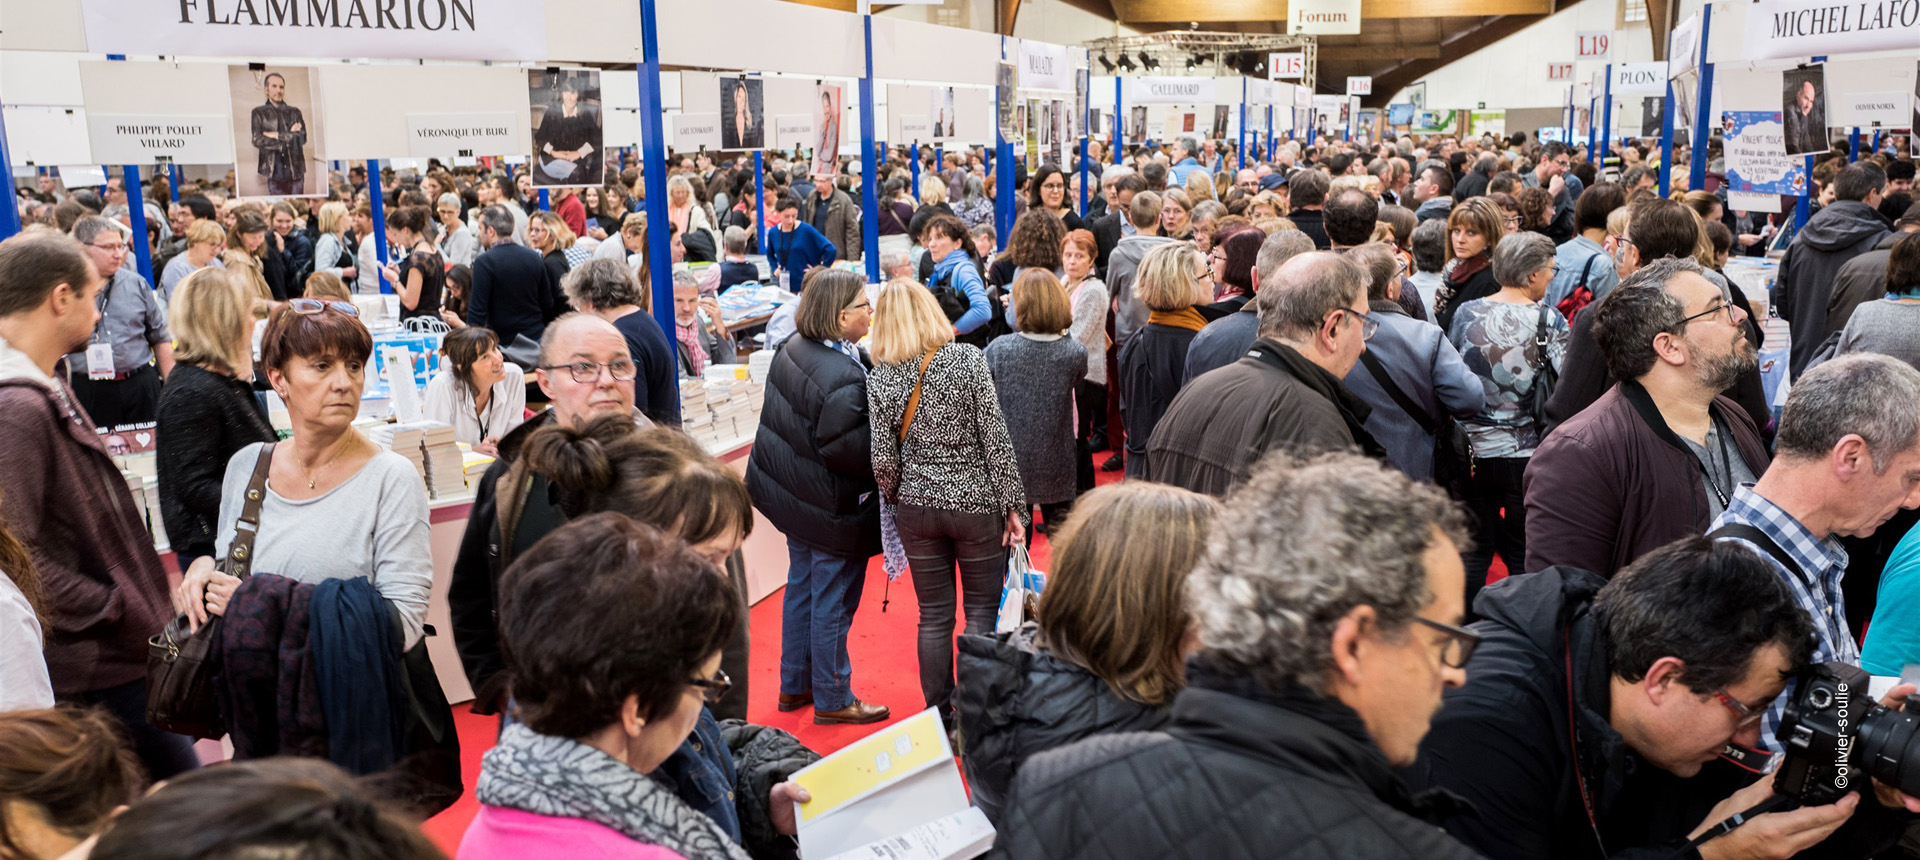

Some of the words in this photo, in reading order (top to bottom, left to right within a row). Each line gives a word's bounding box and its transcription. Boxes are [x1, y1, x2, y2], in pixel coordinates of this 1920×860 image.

[178, 0, 476, 31] FLAMMARION
[1299, 10, 1348, 23] Forum
[1771, 5, 1852, 39] MICHEL
[1857, 0, 1920, 31] LAFO
[1578, 35, 1609, 56] L19
[1275, 57, 1302, 74] L15
[1549, 65, 1573, 79] L17
[1620, 71, 1656, 85] PLON
[1151, 84, 1200, 96] GALLIMARD
[1351, 81, 1369, 91] L16
[116, 125, 163, 135] PHILIPPE
[166, 126, 203, 135] POLLET
[417, 128, 471, 139] VÉRONIQUE
[472, 128, 483, 137] DE
[485, 127, 509, 136] BURE
[140, 139, 185, 148] VILLARD
[115, 423, 135, 432] GÉRARD
